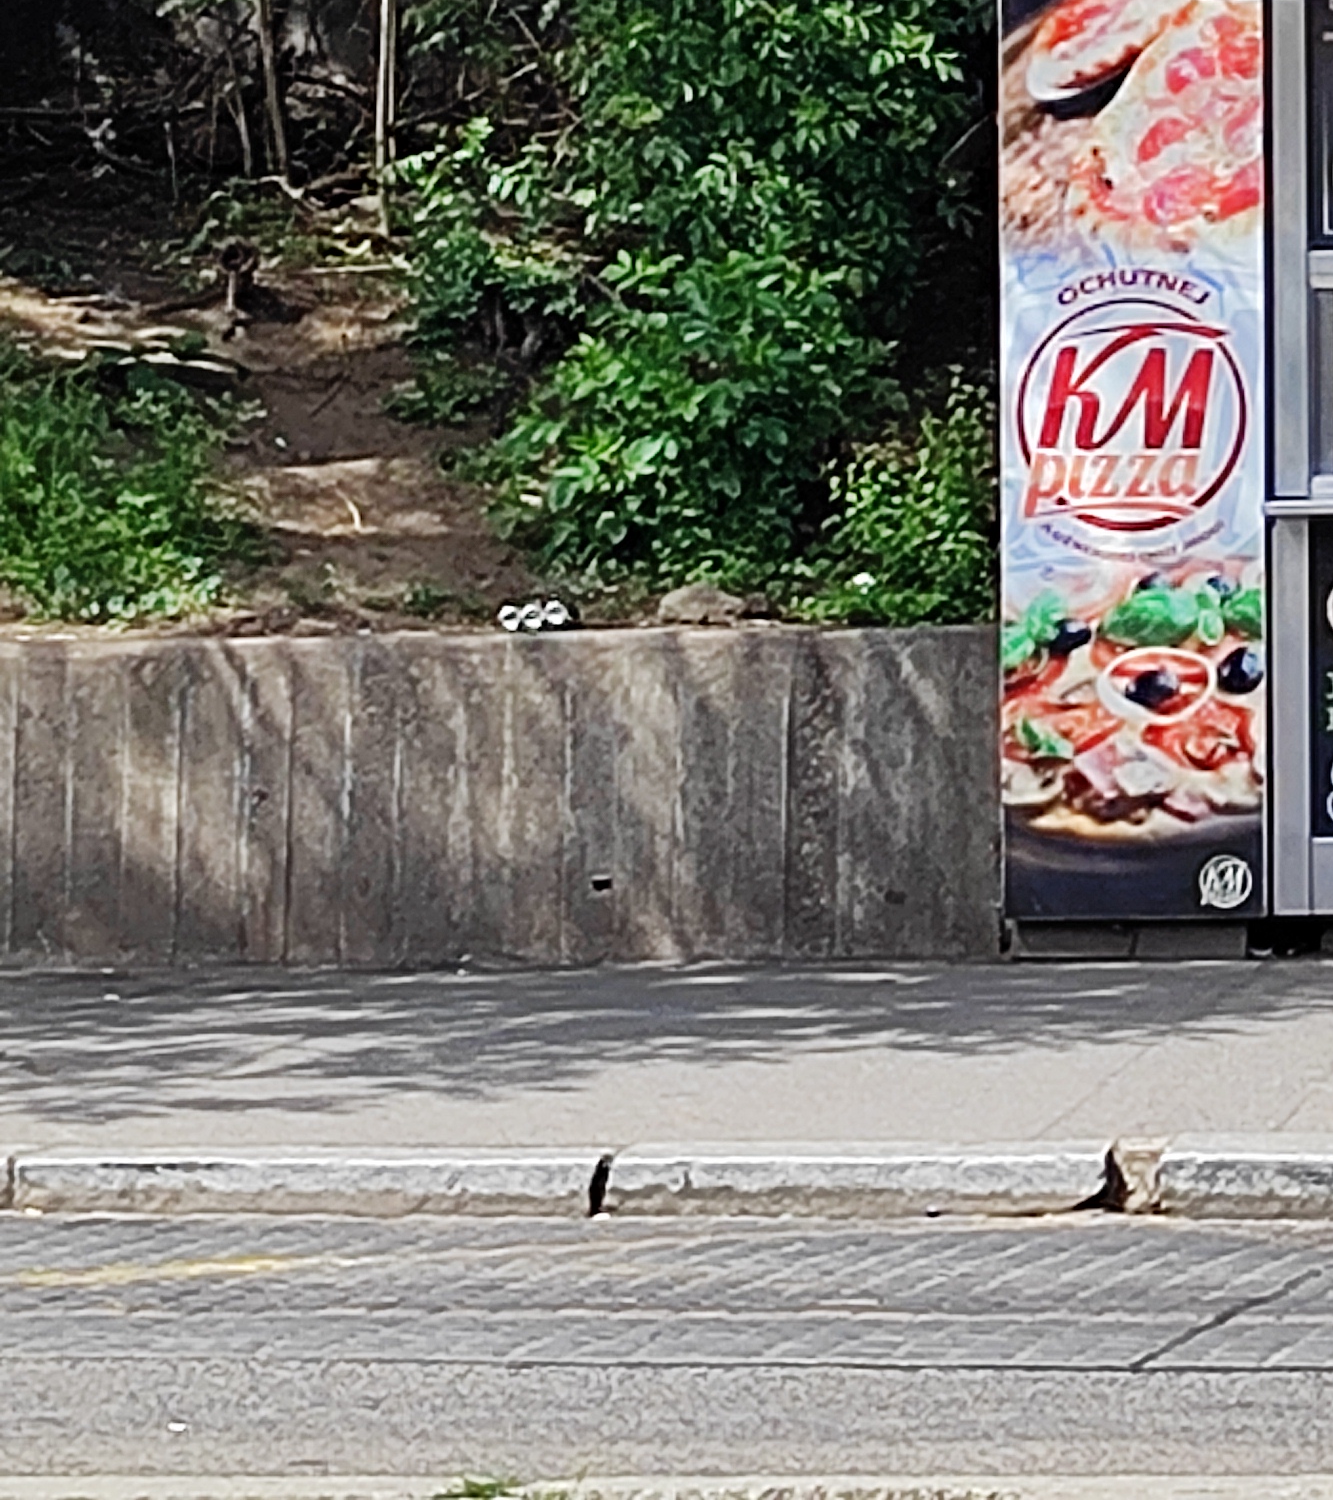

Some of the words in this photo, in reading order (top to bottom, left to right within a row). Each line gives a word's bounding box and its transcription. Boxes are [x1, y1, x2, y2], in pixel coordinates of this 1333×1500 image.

[1057, 268, 1212, 305] OCHUTNEJ
[1036, 322, 1228, 450] KM
[1024, 453, 1200, 518] pizza
